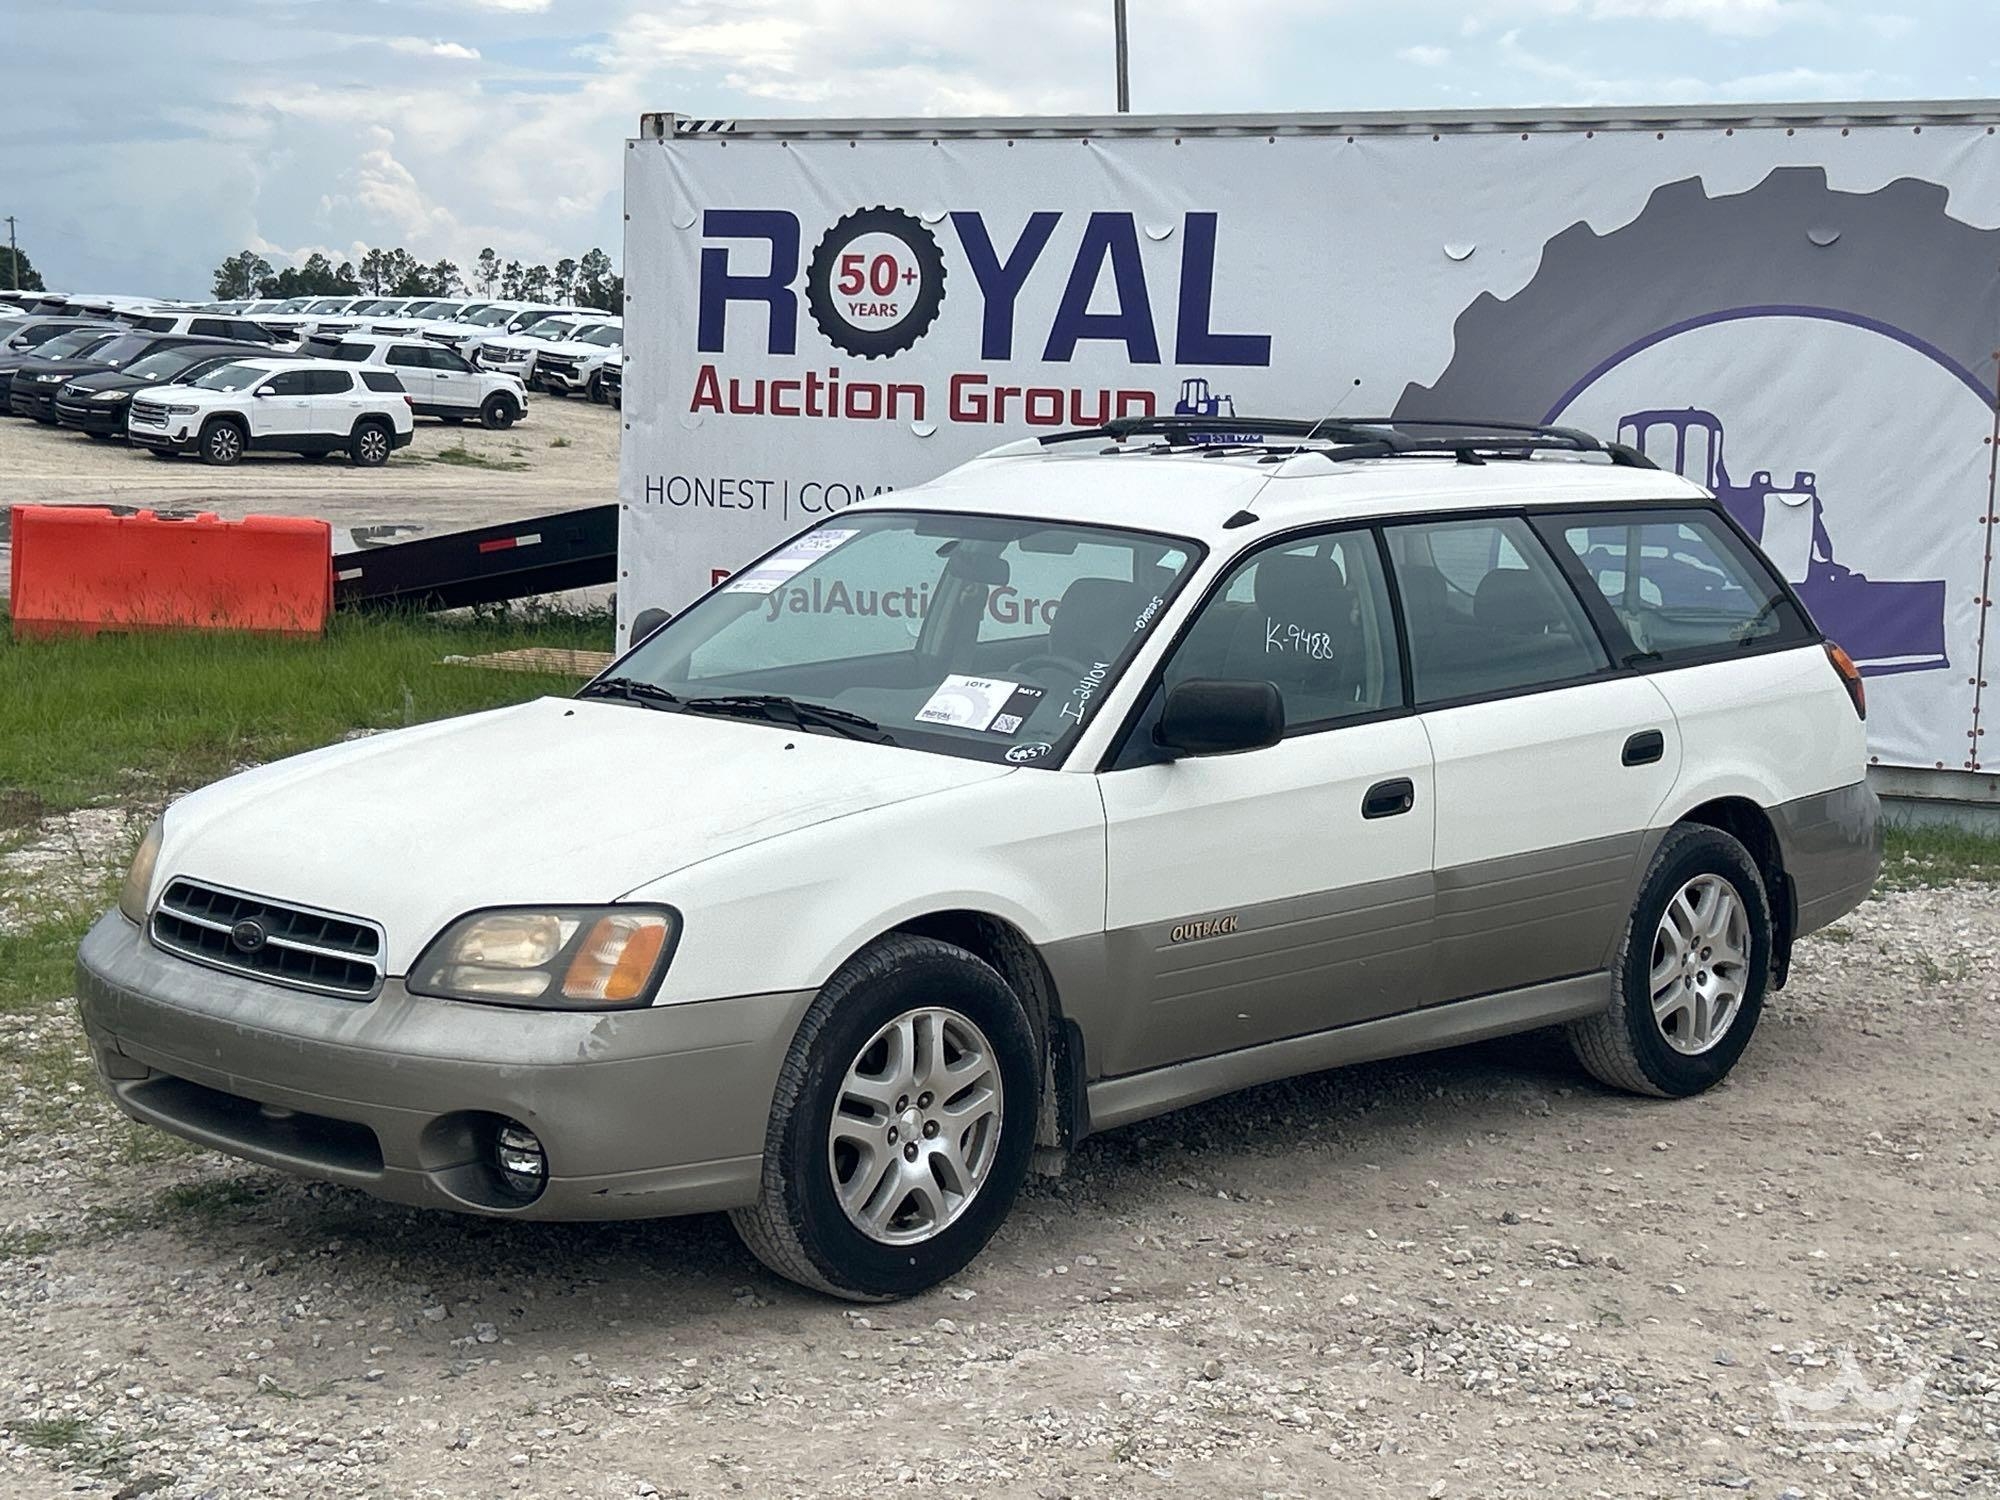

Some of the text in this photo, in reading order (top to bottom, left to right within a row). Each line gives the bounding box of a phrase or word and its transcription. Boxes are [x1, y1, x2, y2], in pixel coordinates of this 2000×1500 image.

[698, 205, 1272, 367] ROYAL
[838, 254, 918, 296] 50+
[848, 303, 898, 317] YEARS
[690, 365, 925, 421] Auction
[646, 475, 775, 511] HONEST
[1266, 616, 1334, 660] K-9488
[1171, 916, 1239, 942] OUTBACK
